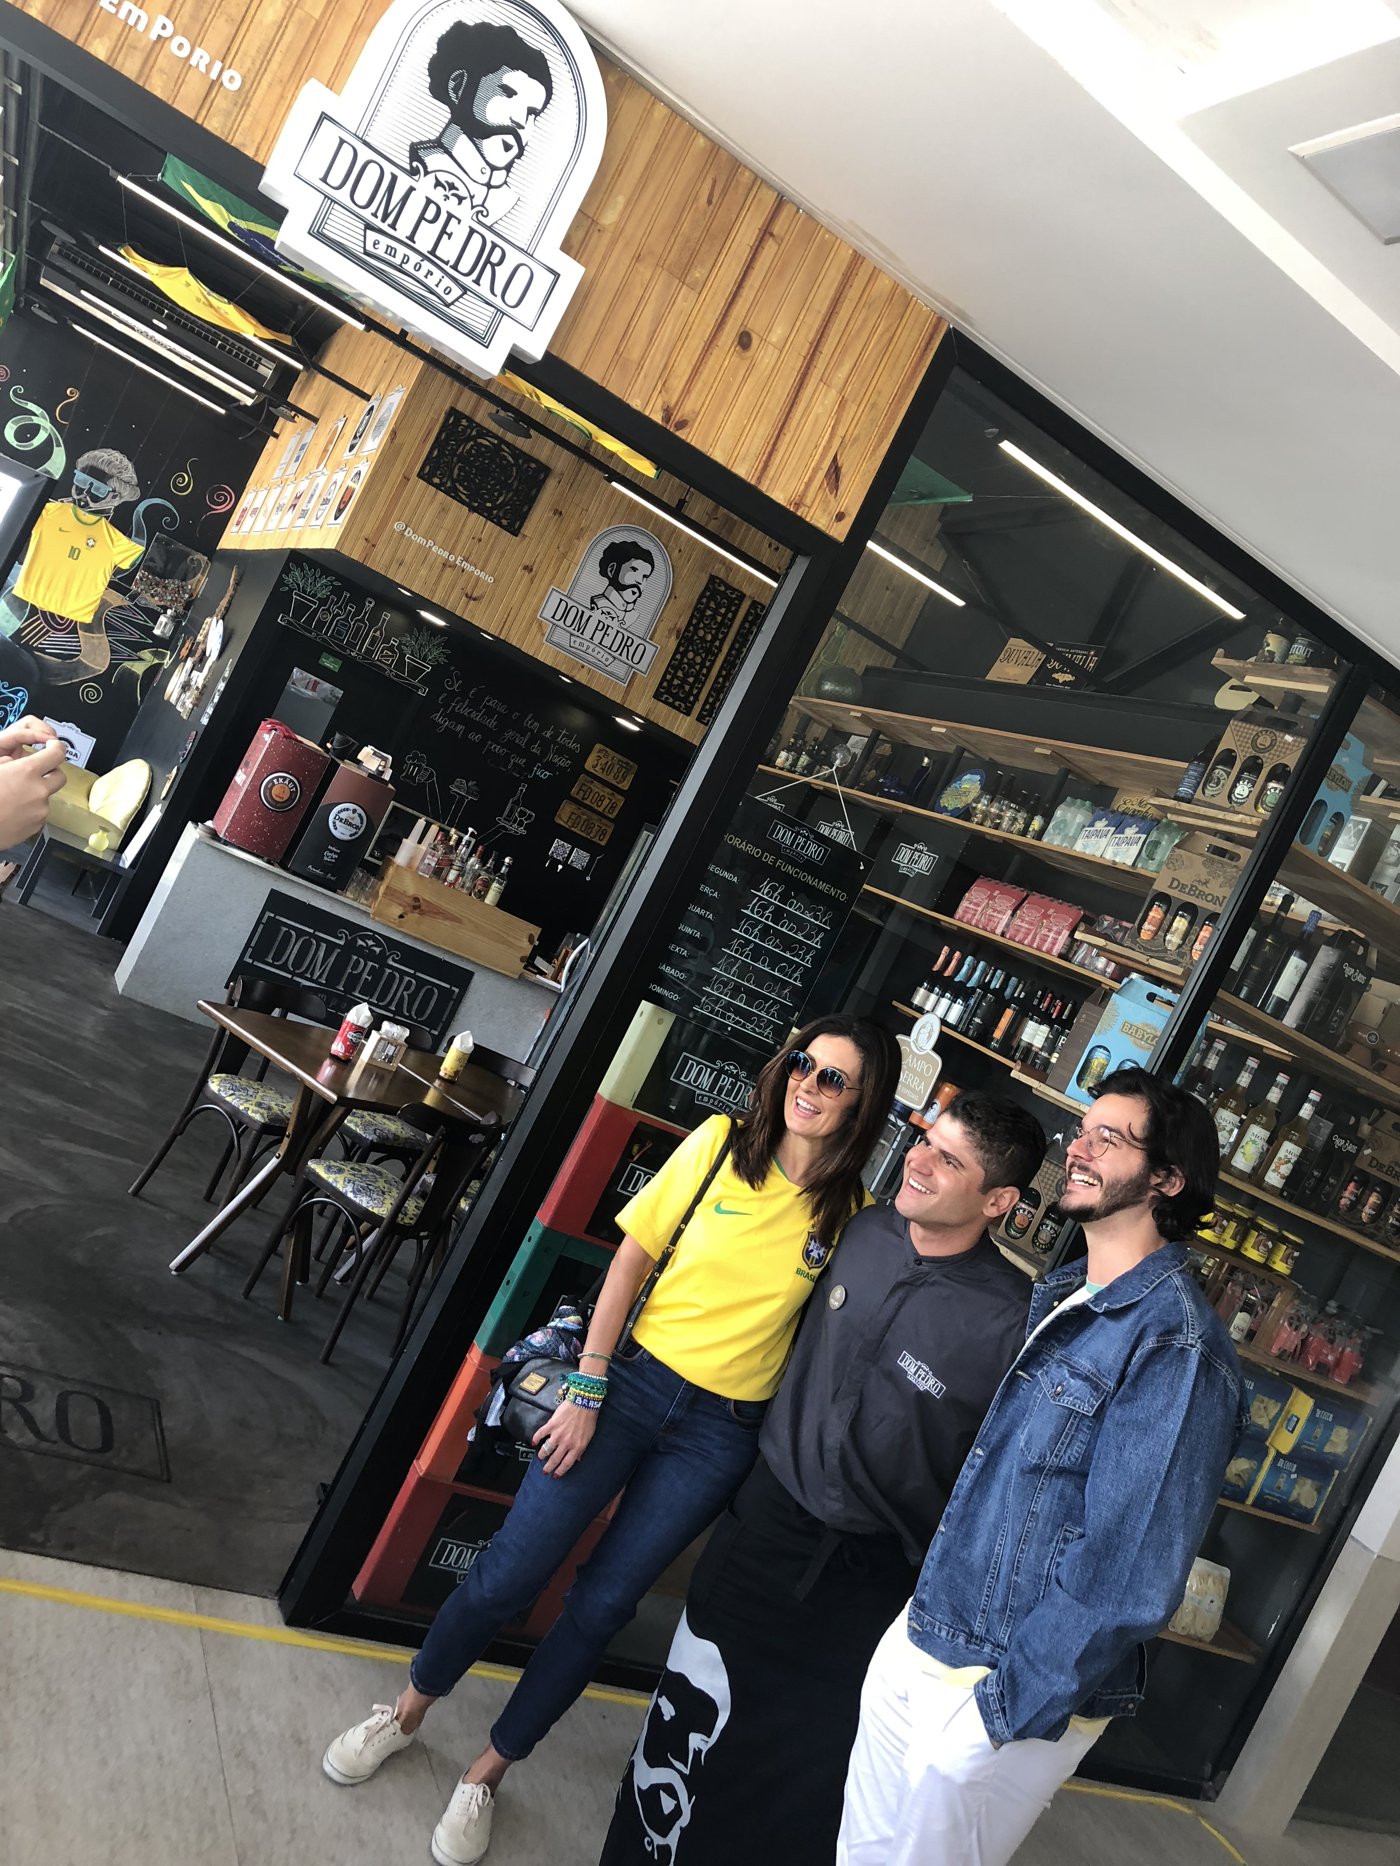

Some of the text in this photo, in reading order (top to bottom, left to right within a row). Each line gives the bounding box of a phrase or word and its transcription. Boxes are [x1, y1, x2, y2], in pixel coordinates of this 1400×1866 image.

[319, 136, 535, 309] DOM PEDRO
[372, 237, 453, 297] empório
[68, 545, 81, 560] 10
[551, 597, 646, 665] DOM PEDRO
[572, 640, 610, 662] empório
[430, 707, 466, 738] digam
[557, 728, 581, 754] todos
[772, 824, 825, 861] DOM PEDRO
[895, 846, 934, 872] DOM PEDRO
[762, 852, 776, 866] DE
[776, 859, 849, 903] FUNCIONAMENTO:
[747, 896, 775, 922] 16h
[797, 922, 825, 947] 23h
[759, 878, 785, 903] 16h
[805, 904, 833, 926] 23h
[728, 938, 755, 961] 16h
[775, 963, 804, 984] 01h
[738, 917, 764, 941] 16h
[785, 943, 816, 966] 23h
[264, 925, 439, 1022] DOM PEDRO
[717, 954, 742, 979] 16h
[763, 981, 793, 1001] 01h
[695, 995, 724, 1018] 16h
[706, 974, 735, 999] 16h
[753, 999, 780, 1019] 01h
[680, 1060, 718, 1091] DOM
[901, 1355, 941, 1394] DOM PEDRO
[439, 1543, 480, 1570] DOM
